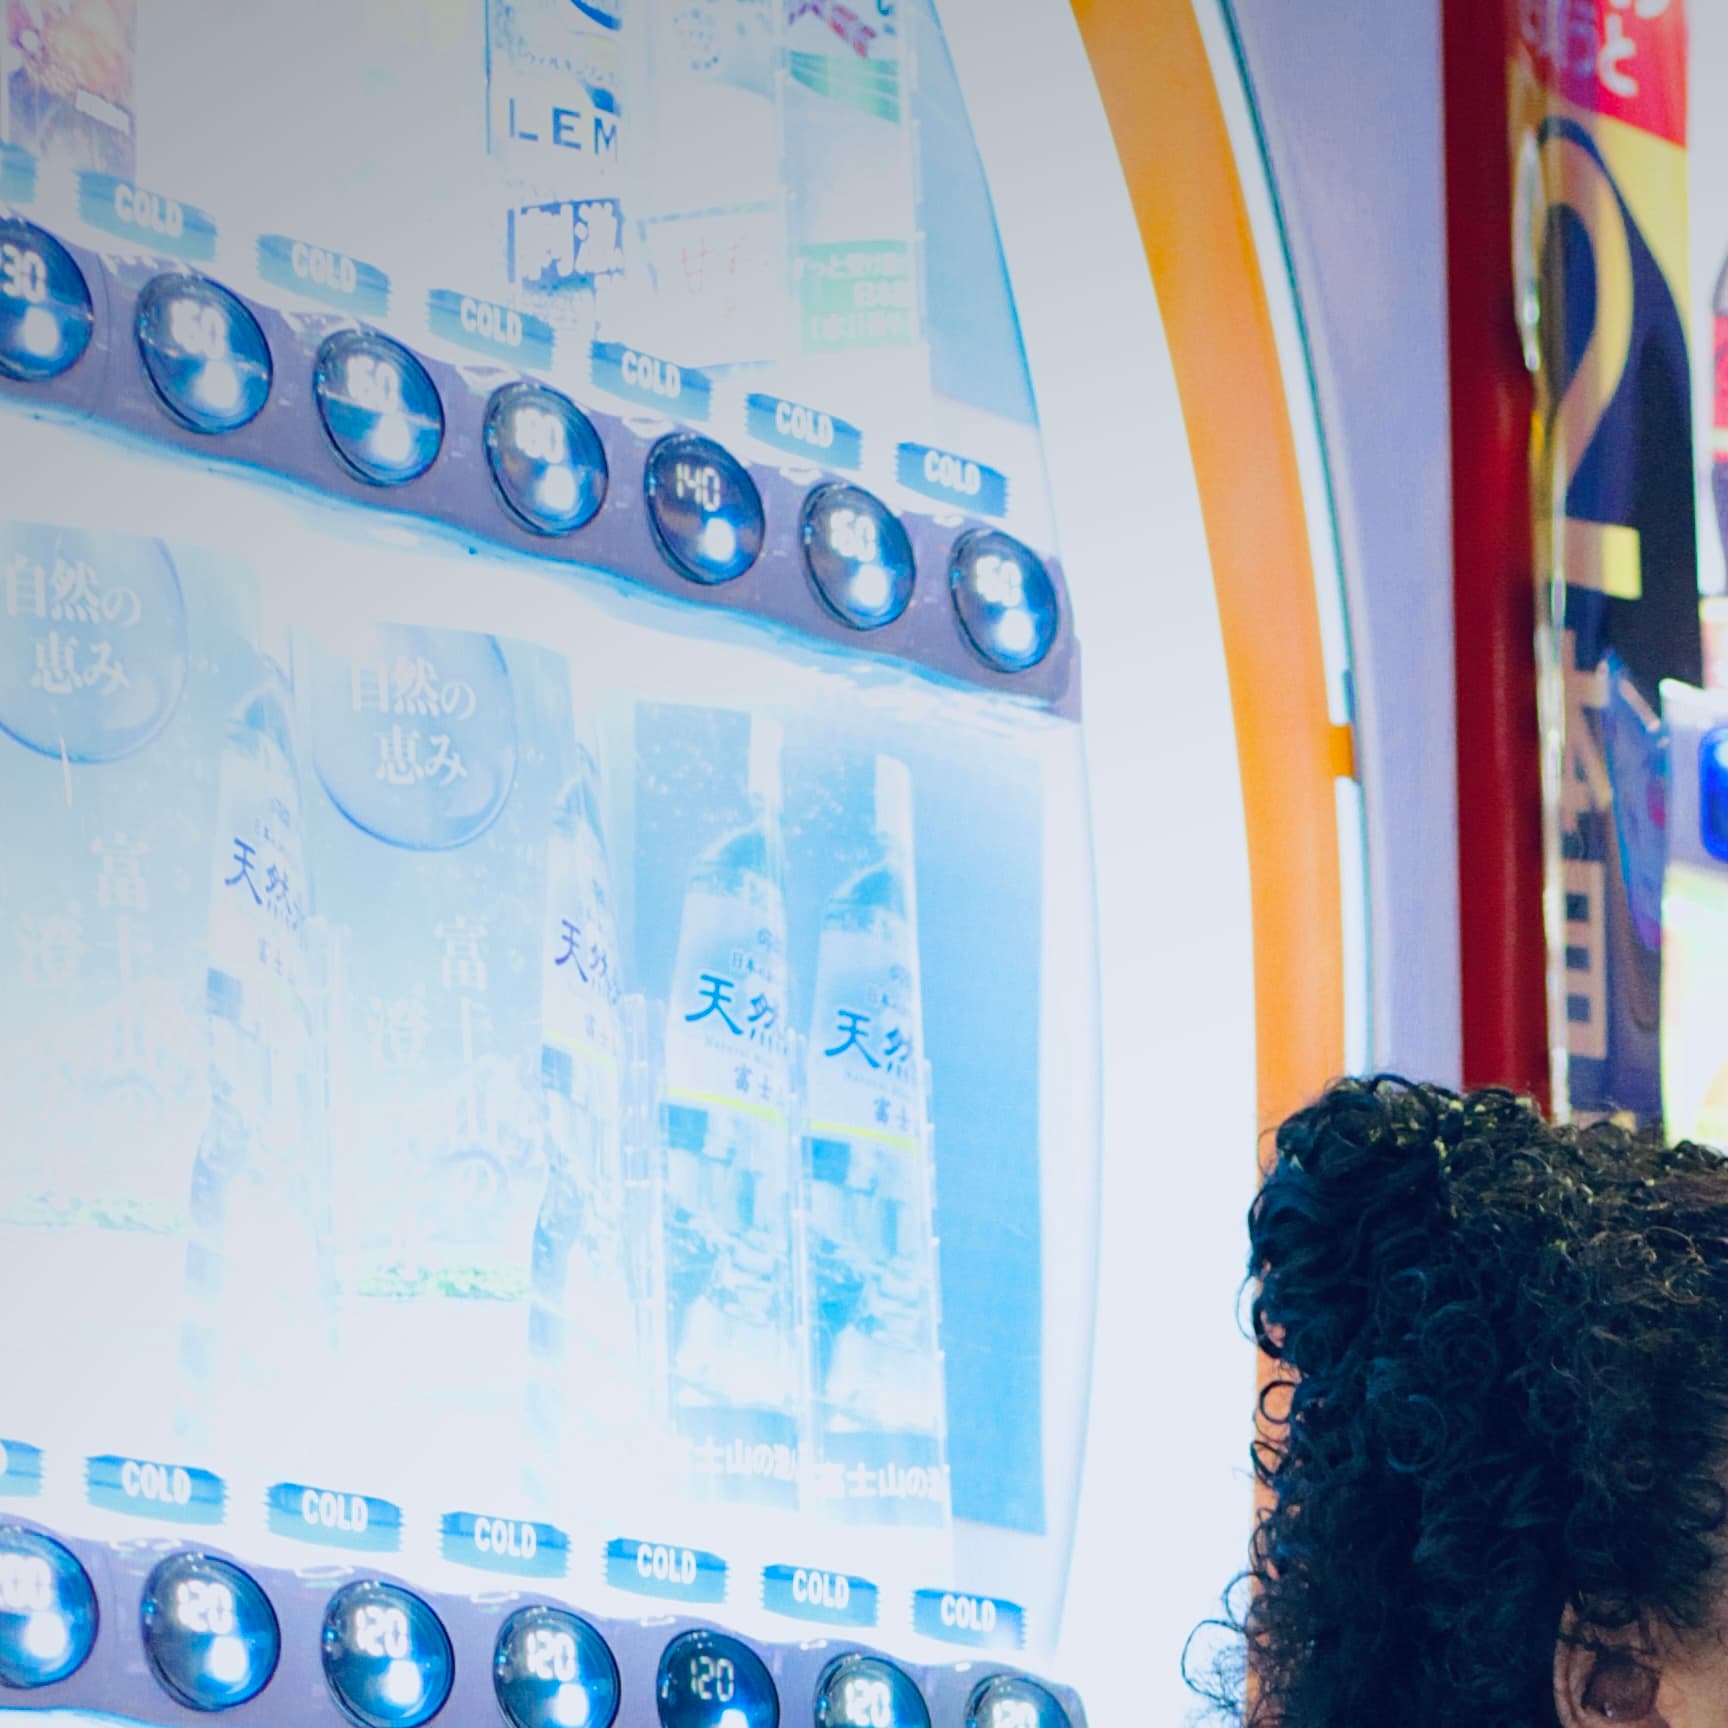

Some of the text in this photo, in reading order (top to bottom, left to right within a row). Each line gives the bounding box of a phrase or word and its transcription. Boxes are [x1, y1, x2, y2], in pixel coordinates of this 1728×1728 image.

[114, 181, 184, 240] COLD
[291, 242, 358, 295] COLD
[459, 294, 523, 347] COLD
[620, 351, 682, 398] COLD
[775, 402, 834, 448] COLD
[675, 462, 722, 513] 140
[923, 451, 981, 496] COLD
[30, 634, 130, 697] 恵み
[351, 656, 478, 722] 自然の
[375, 725, 468, 786] 恵み
[121, 1460, 191, 1506] COLD
[301, 1489, 369, 1533] COLD
[473, 1517, 538, 1560] COLD
[636, 1543, 697, 1586] COLD
[792, 1568, 850, 1610] COLD
[176, 1579, 233, 1636] 120
[939, 1595, 996, 1633] COLD
[354, 1606, 408, 1659] 120
[526, 1631, 576, 1682] 120
[690, 1655, 735, 1702] 120
[844, 1679, 892, 1728] 120
